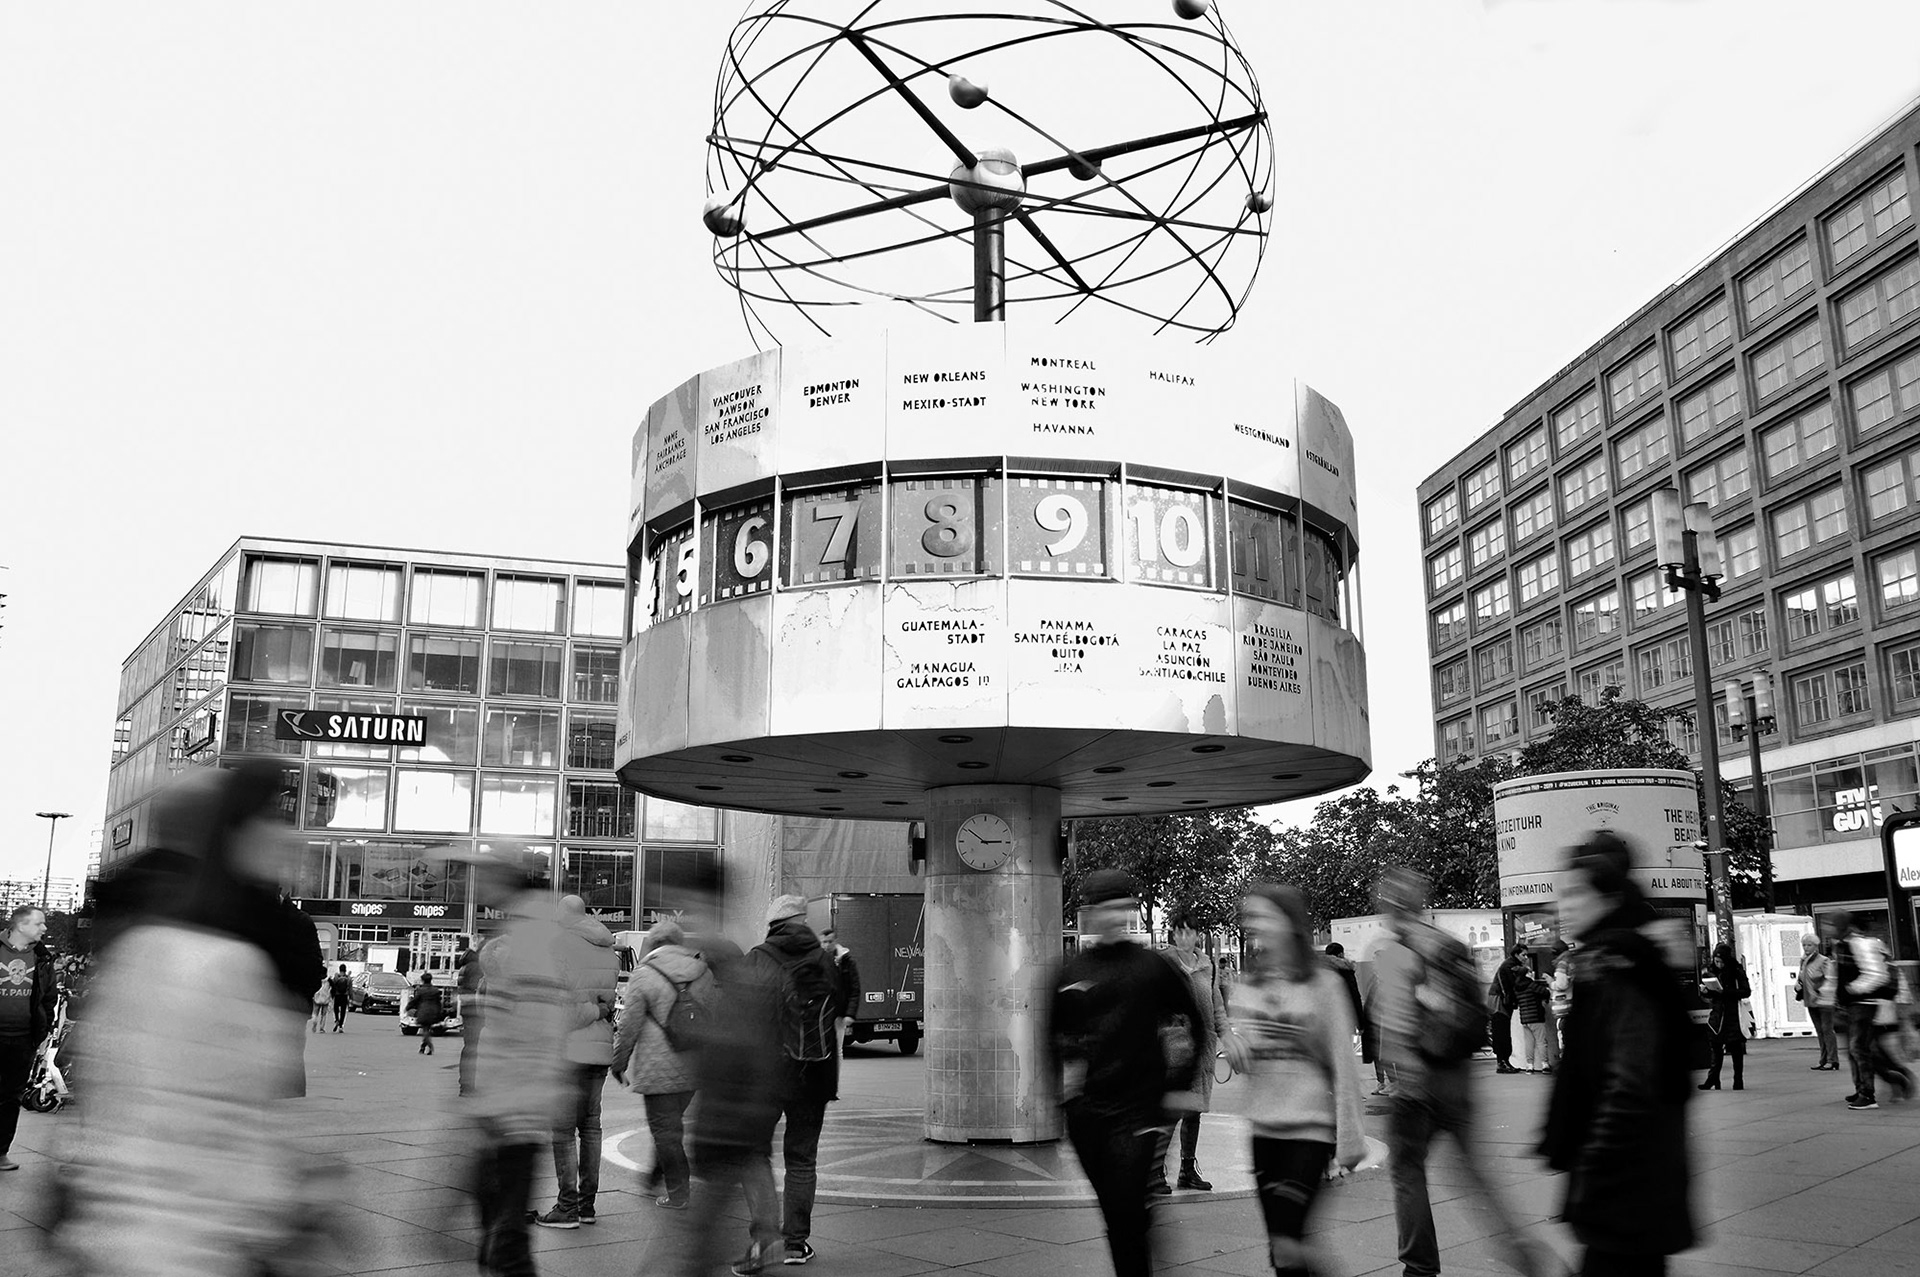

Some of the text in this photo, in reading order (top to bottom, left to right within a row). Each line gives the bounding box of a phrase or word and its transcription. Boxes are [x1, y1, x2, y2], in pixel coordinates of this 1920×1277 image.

[1031, 357, 1096, 371] MONTREAL
[904, 371, 986, 384] NEW ORLEANS
[1149, 370, 1196, 387] HALIFAX
[803, 378, 860, 397] EDMONTON
[1021, 383, 1106, 397] WASHINGTON
[712, 385, 762, 408] VANCOUVER
[810, 392, 851, 408] DENVER
[903, 397, 987, 410] MEXIKO-STADT
[1031, 397, 1096, 410] NEW YORK
[719, 399, 755, 418] DAWSON
[704, 407, 769, 435] SAN FRANCISCO
[1033, 422, 1095, 435] HAVANNA
[711, 422, 761, 445] LOS ANGELES
[1233, 423, 1290, 449] WESTGRÖNLAND
[812, 499, 863, 566] 7
[921, 493, 974, 558] 8
[1034, 494, 1089, 558] 9
[1127, 498, 1205, 568] 10
[733, 516, 769, 579] 6
[676, 537, 696, 597] 5
[901, 619, 985, 632] GUATEMALA-
[1040, 619, 1094, 632] PANAMA
[1156, 626, 1207, 640] CARACAS
[1254, 623, 1292, 640] BRASILIA
[947, 633, 985, 644] STADT
[1243, 635, 1303, 656] RIO DE JANEIRO
[1051, 648, 1085, 659] QUITO
[1163, 641, 1201, 654] LA PAZ
[911, 662, 976, 674] MANAGUA
[1156, 654, 1210, 668] ASUNCIÓN
[1271, 653, 1294, 667] PAULO
[1197, 671, 1226, 683] CHILE
[1251, 663, 1298, 680] MONTEVIDEO
[897, 674, 969, 688] GALÁPAGOS
[1248, 676, 1302, 695] BUENOS AIRES
[327, 713, 423, 742] SATURN
[1835, 784, 1880, 811] FIVE
[1664, 809, 1683, 823] THE
[1833, 805, 1884, 833] GUYS
[1508, 883, 1553, 896] INFORMATION
[1651, 878, 1668, 889] ALL
[1671, 878, 1692, 889] ABOUT
